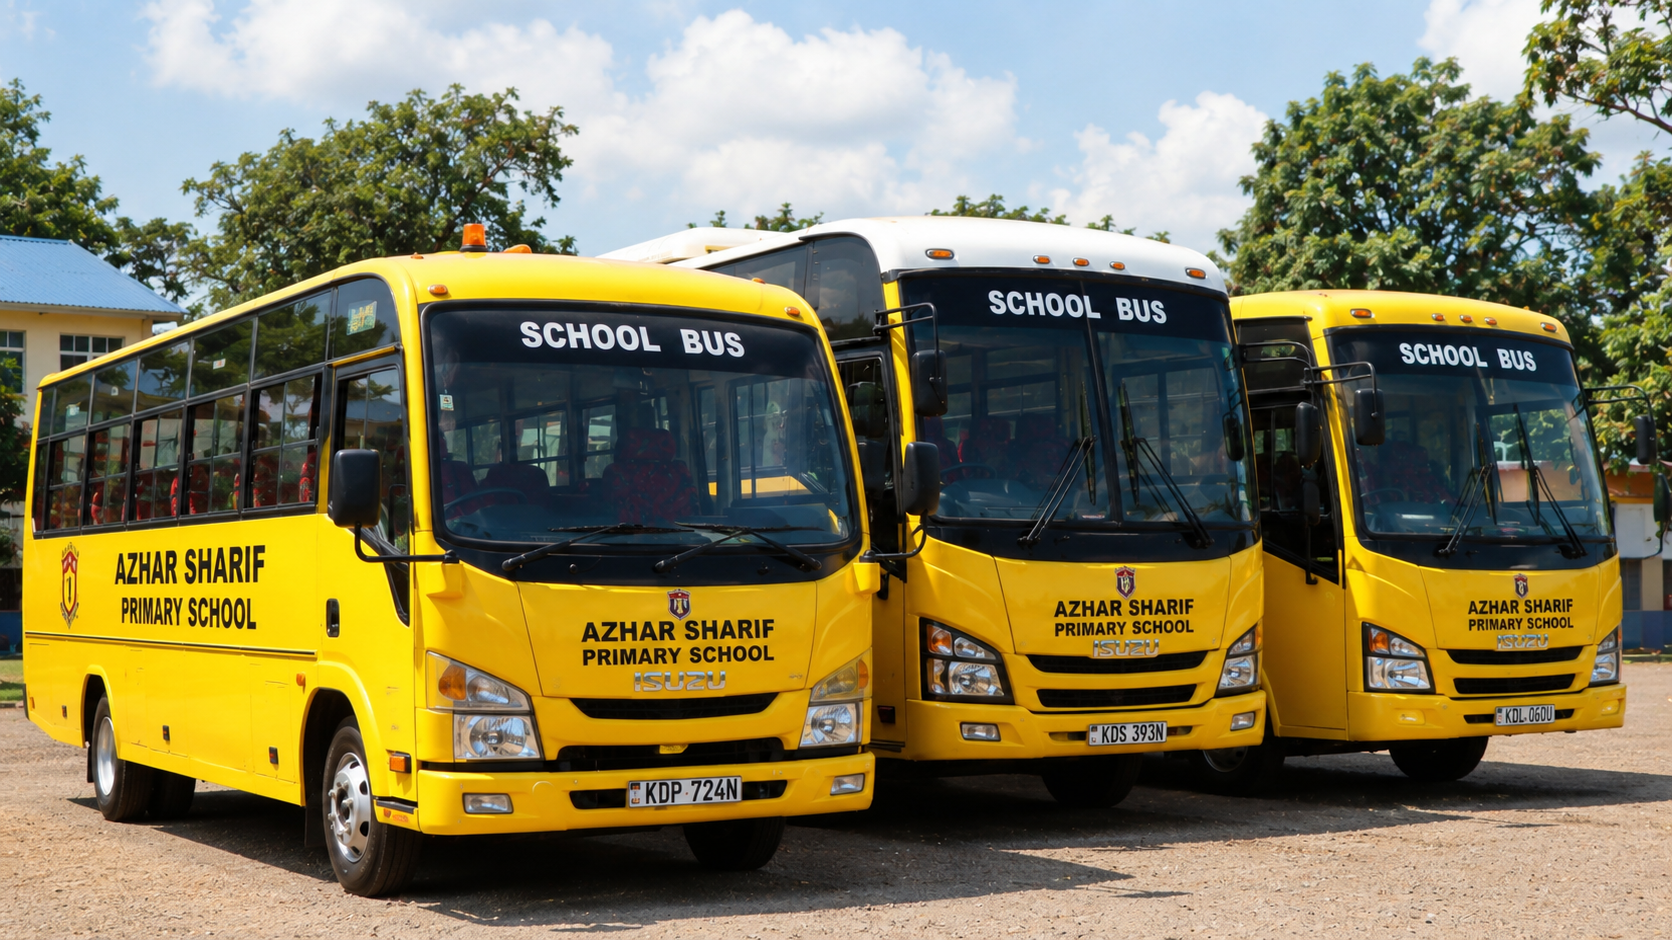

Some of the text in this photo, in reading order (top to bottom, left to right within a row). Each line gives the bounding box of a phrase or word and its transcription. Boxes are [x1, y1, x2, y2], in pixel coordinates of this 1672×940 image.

[988, 290, 1168, 324] SCHOOL BUS
[519, 321, 745, 359] SCHOOL BUS
[1399, 342, 1537, 372] SCHOOL BUS
[114, 545, 266, 585] AZHAR SHARIF
[121, 597, 257, 630] PRIMARY SCHOOL
[1053, 598, 1195, 618] AZHAR SHARIF
[1467, 598, 1574, 615] AZHAR SHARIF
[581, 618, 775, 643] AZHAR SHARIF
[1054, 619, 1195, 637] PRIMARY SCHOOL
[1468, 616, 1574, 632] PRIMARY SCHOOL
[1093, 639, 1159, 657] ISUZU
[1497, 634, 1549, 650] ISUZU
[582, 644, 775, 667] PRIMARY SCHOOL
[634, 670, 726, 692] ISUZU
[1505, 707, 1525, 724] KDL
[1101, 722, 1164, 744] KDS 393N
[645, 778, 738, 805] KDP 724N
